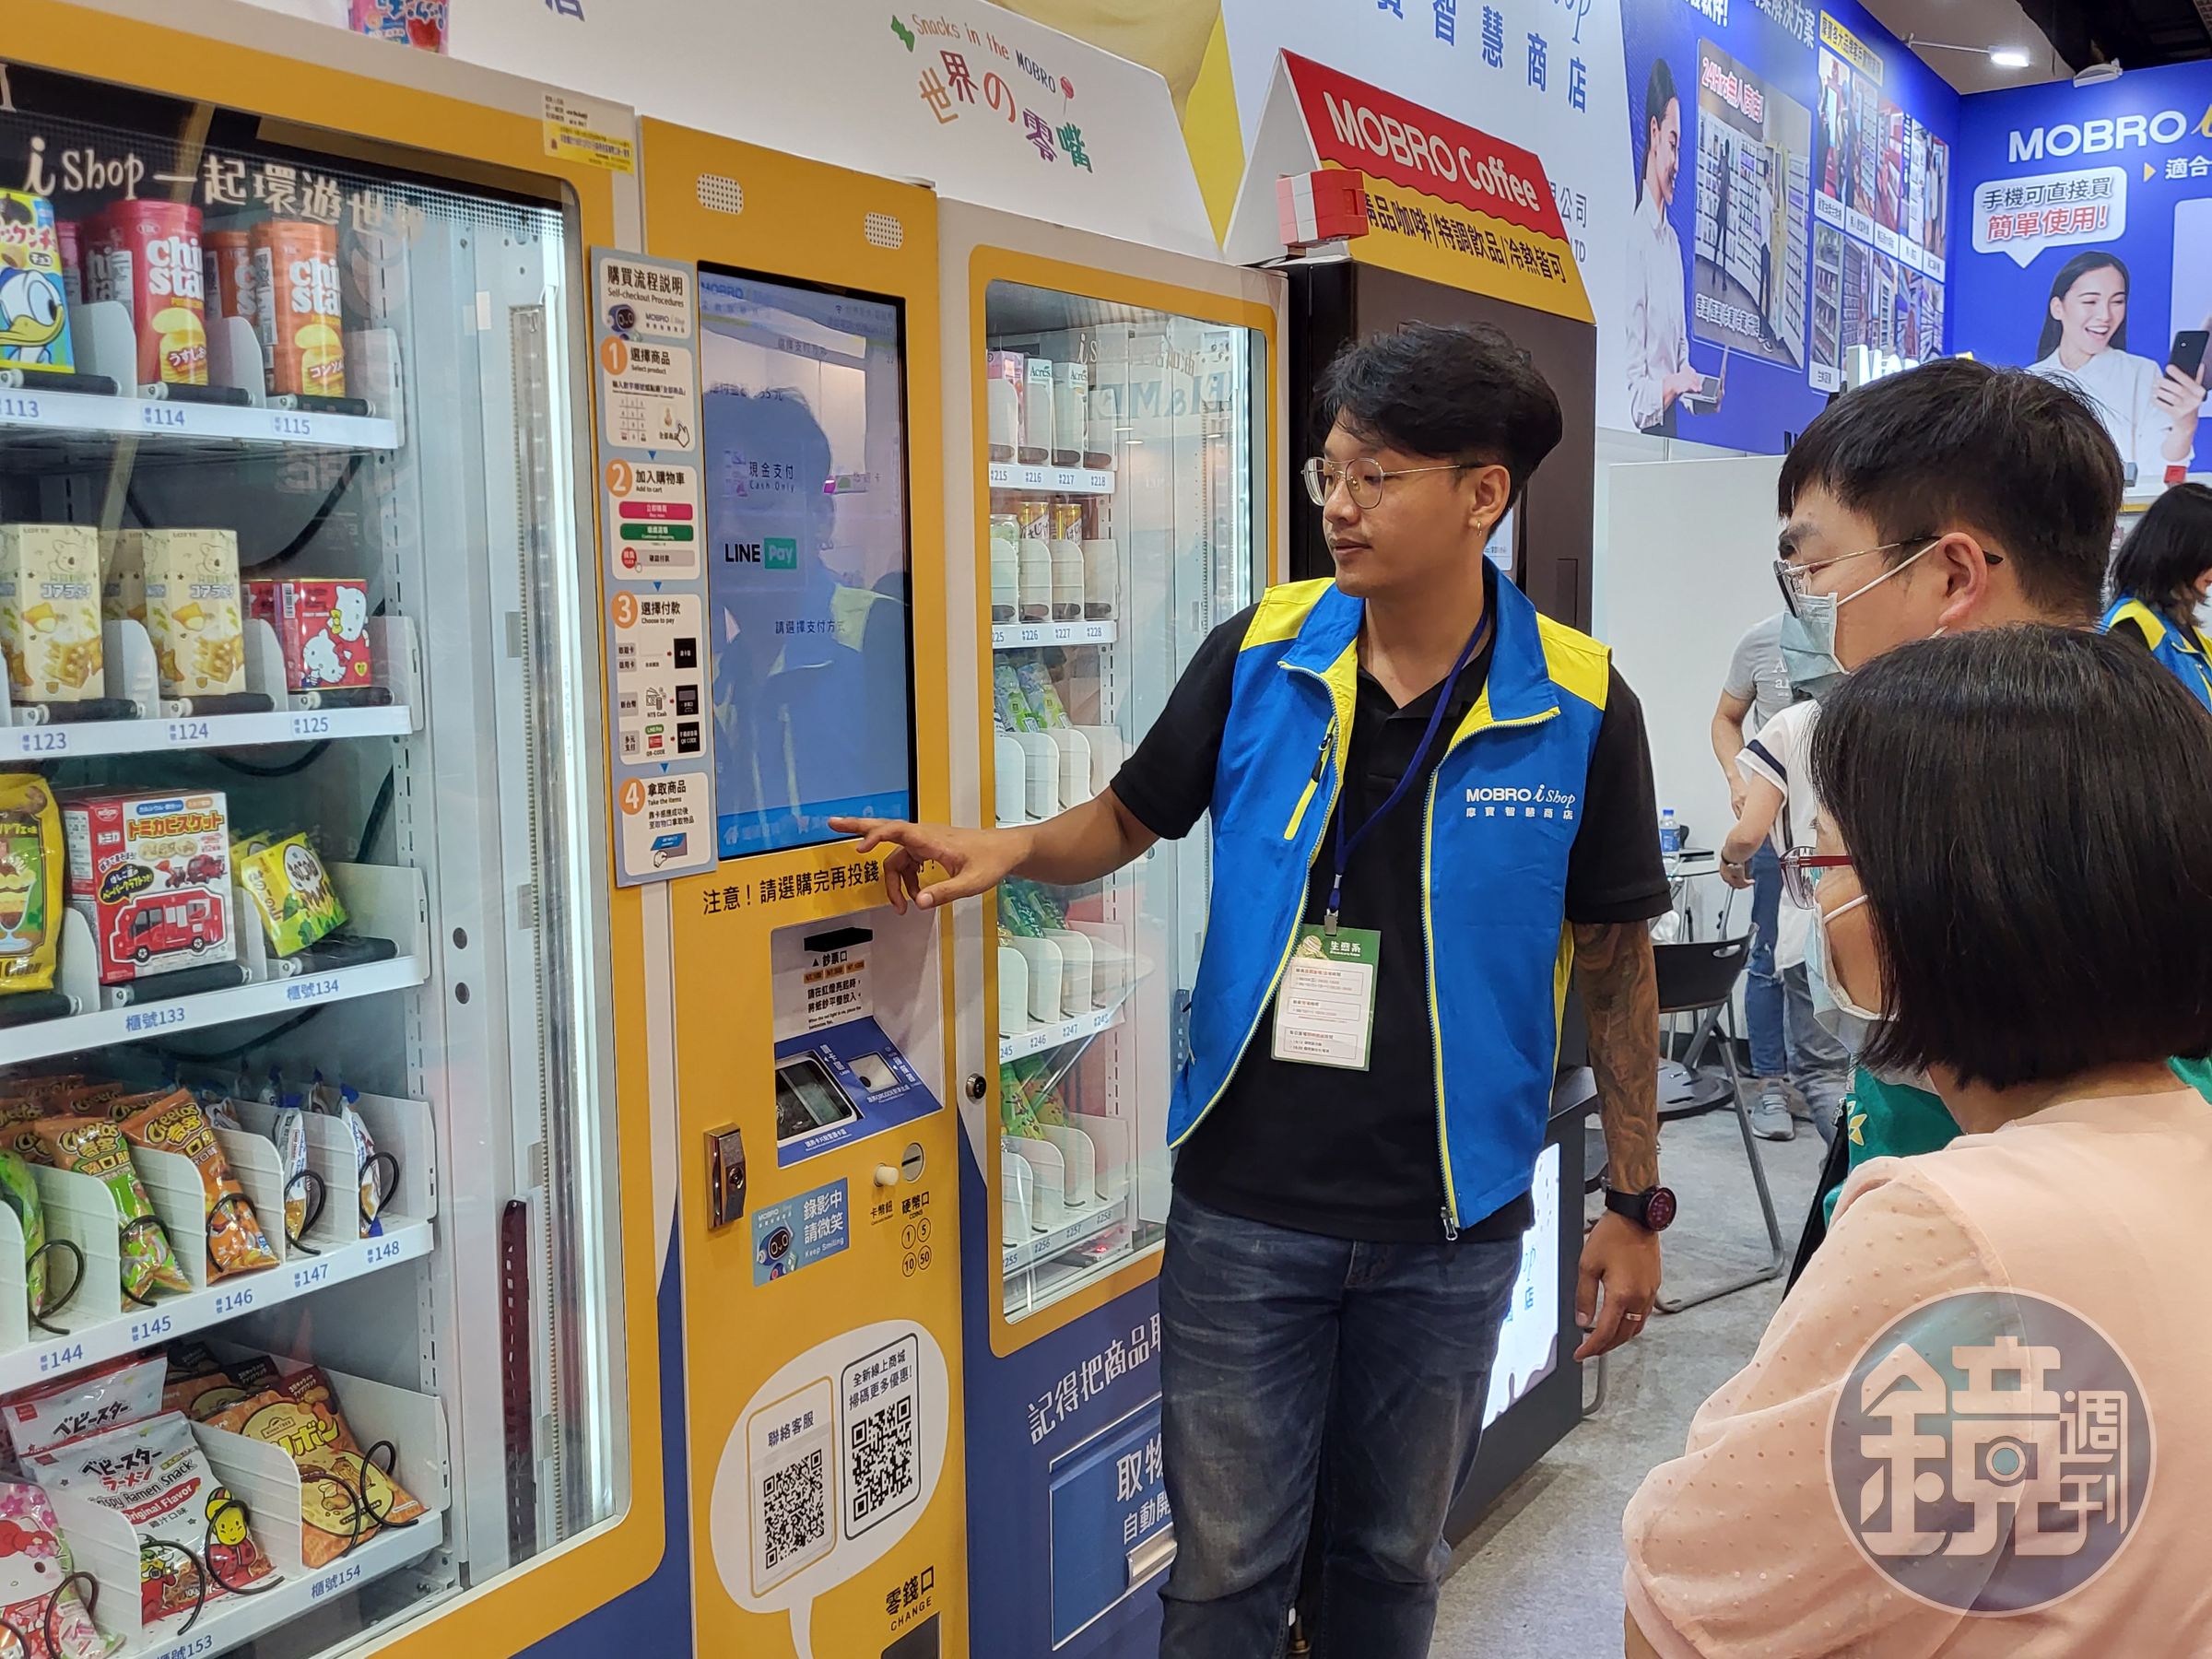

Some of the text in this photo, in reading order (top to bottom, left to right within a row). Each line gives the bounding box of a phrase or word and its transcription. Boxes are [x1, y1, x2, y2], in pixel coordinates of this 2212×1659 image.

[912, 14, 1056, 94] Snacks in the MOBRO
[2008, 111, 2188, 163] MOBRO
[1324, 91, 1540, 213] MOBRO Coffee
[63, 150, 144, 200] Shop
[2166, 156, 2212, 180] 適合
[1549, 182, 1587, 229] 公司
[1983, 176, 2112, 211] 手機可直接買
[1987, 206, 2108, 243] 簡單使用!
[608, 288, 684, 308] Self-checkout Procedures
[609, 342, 618, 370] 1
[630, 347, 670, 366] 選擇商品
[5, 399, 39, 419] 113
[153, 408, 185, 427] 114
[283, 418, 311, 436] 115
[612, 463, 627, 492] 2
[636, 469, 685, 488] 加入購物車
[749, 461, 794, 479] 現金支付
[749, 481, 771, 490] Cash
[724, 543, 794, 564] LINE Pay
[618, 594, 631, 624] 3
[641, 601, 681, 618] 選擇付款
[179, 724, 208, 740] 124
[302, 717, 329, 735] 125
[33, 733, 67, 751] 123
[625, 781, 641, 809] 4
[648, 780, 686, 796] 拿取商品
[1466, 788, 1532, 802] MOBRO
[1546, 790, 1576, 808] Shop
[127, 812, 225, 841] トミカビスケット
[286, 980, 339, 1002] 櫃號134
[125, 1008, 185, 1032] 櫃號133
[147, 1103, 199, 1143] Cheetos
[804, 1189, 842, 1221] 錄影中
[901, 1191, 930, 1215] 硬幣口
[804, 1215, 843, 1244] 請微笑
[374, 1241, 400, 1263] 148
[805, 1237, 844, 1258] Keep Smiling
[904, 1251, 930, 1272] 10 50
[302, 1264, 329, 1287] 147
[225, 1289, 253, 1312] 146
[141, 1316, 172, 1340] 145
[51, 1344, 84, 1370] 144
[853, 1349, 906, 1388] 全新線上商城
[849, 1369, 912, 1411] 掃碼更多優惠!
[53, 1400, 130, 1436] ベビースター
[768, 1410, 814, 1448] 聯絡客服
[81, 1447, 163, 1477] ベビースター
[102, 1466, 155, 1491] ラーメン
[124, 1482, 162, 1504] Ramen
[160, 1458, 197, 1488] Snack
[162, 1483, 194, 1512] Flavor
[312, 1566, 361, 1598] 櫃號154
[886, 1565, 934, 1615] 零錢口
[890, 1595, 933, 1631] CHANGE
